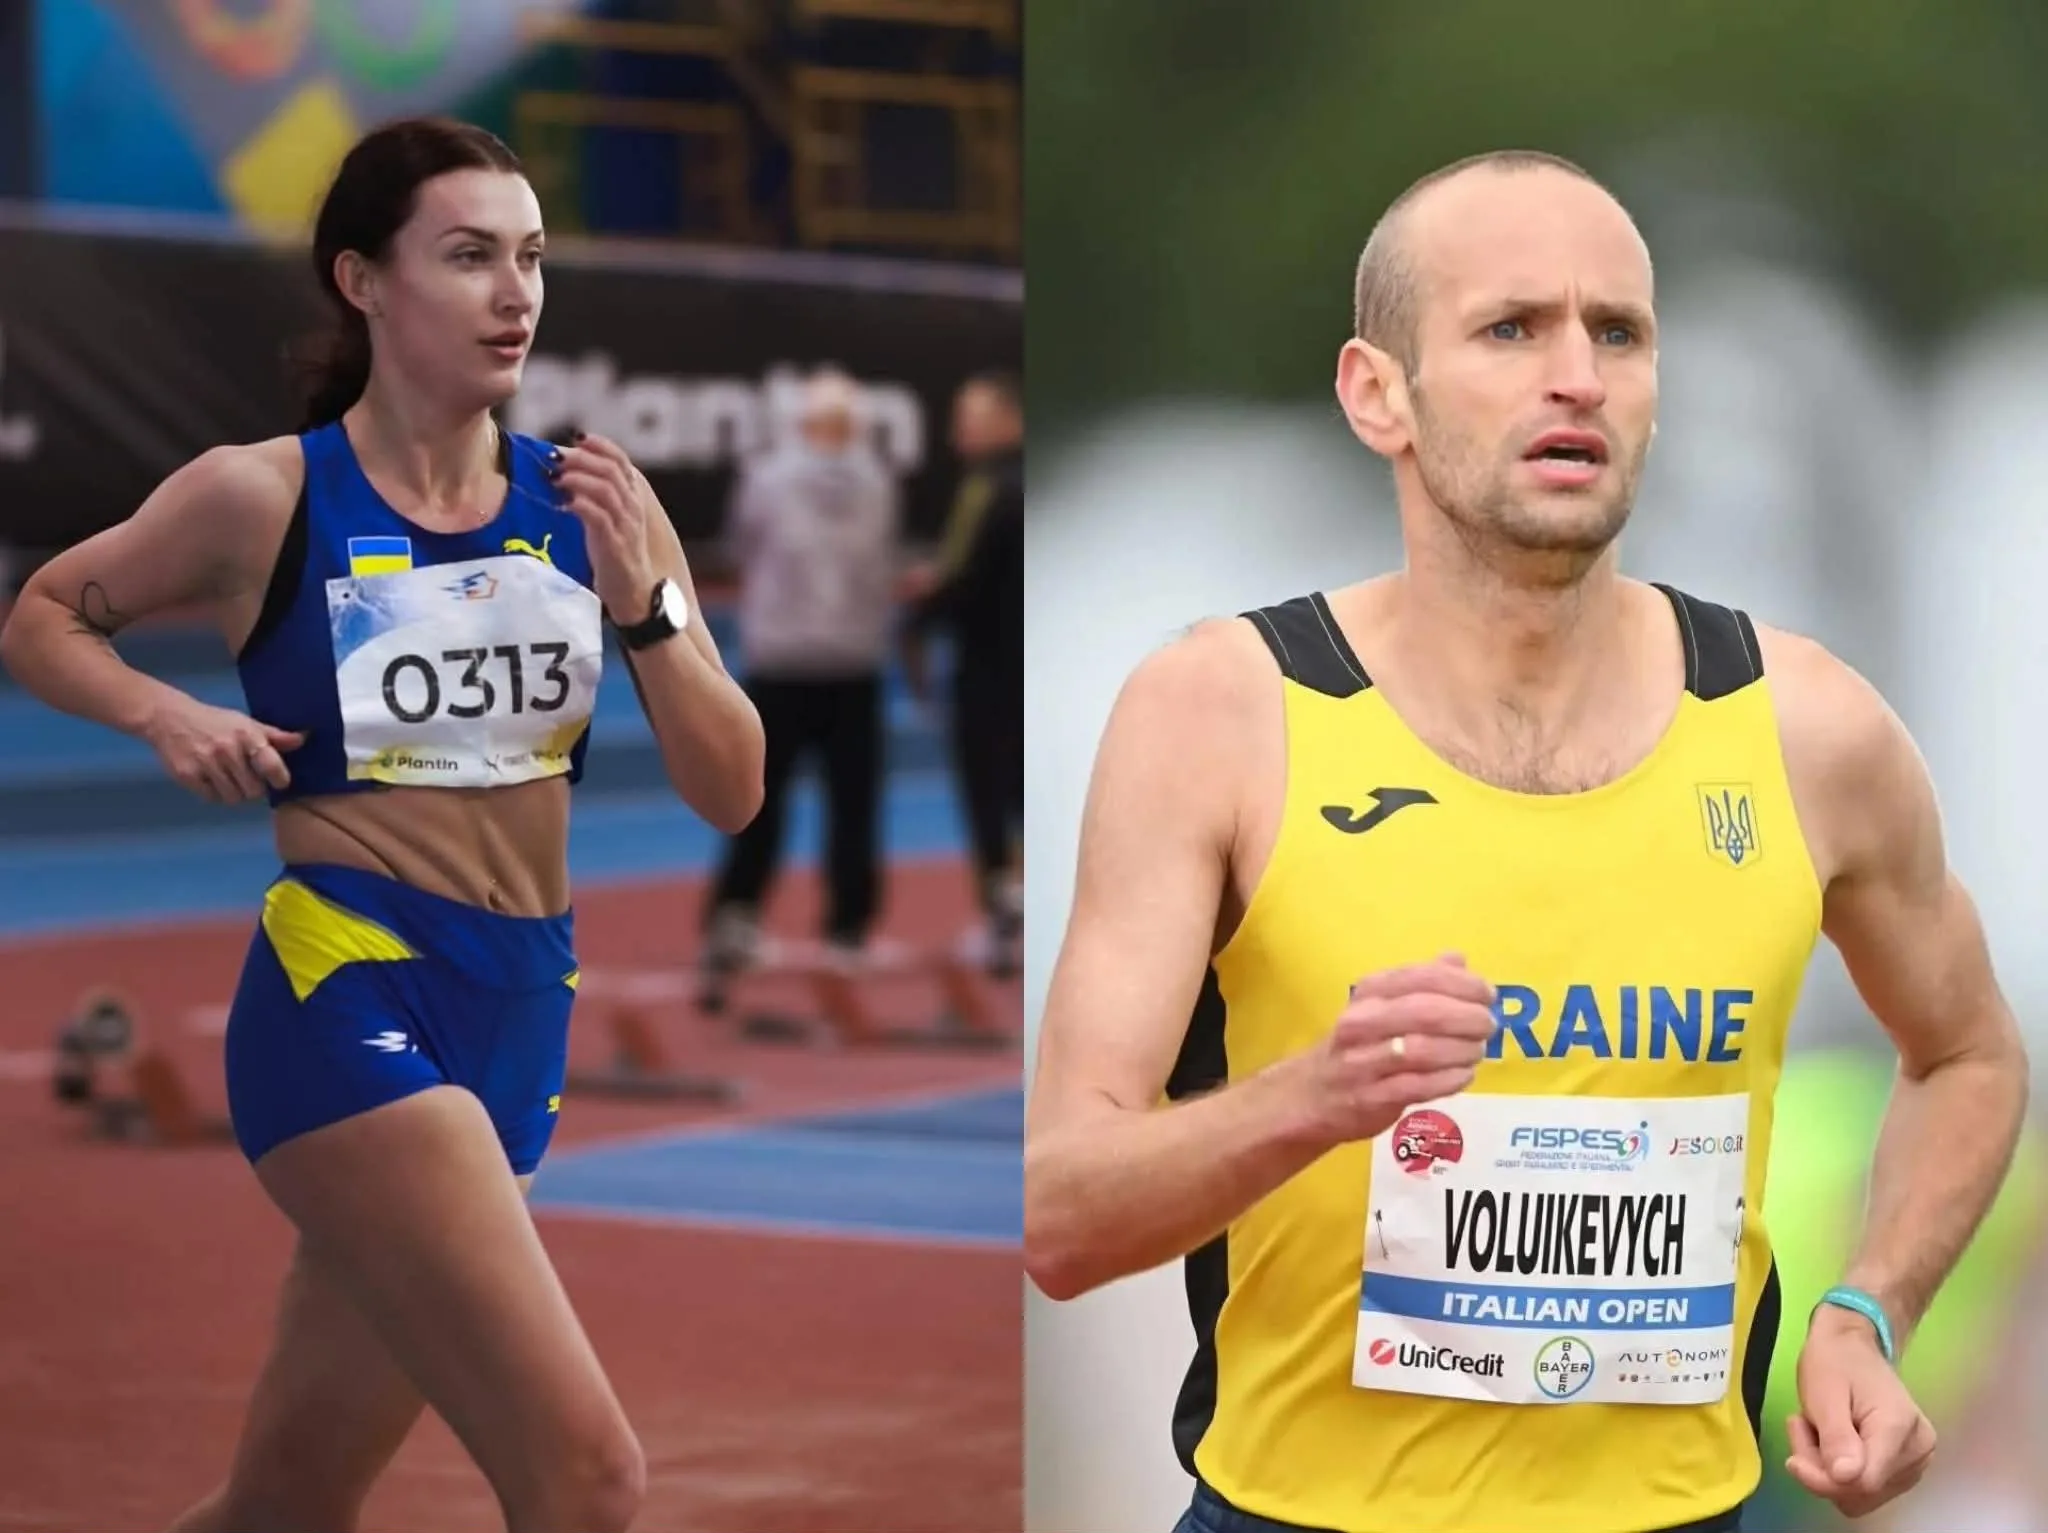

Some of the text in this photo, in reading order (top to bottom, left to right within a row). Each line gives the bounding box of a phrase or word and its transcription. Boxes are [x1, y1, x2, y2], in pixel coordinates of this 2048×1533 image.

[382, 642, 570, 724] 0313
[397, 756, 459, 771] Plantin
[1350, 984, 1753, 1062] RAINE
[1510, 1127, 1622, 1150] FISPES
[1445, 1189, 1686, 1277] VOLUIKEVYCH
[1442, 1292, 1689, 1323] ITALIAN OPEN
[1398, 1343, 1505, 1378] UniCredit
[1539, 1361, 1590, 1373] BAYER
[1557, 1341, 1572, 1393] BAYER
